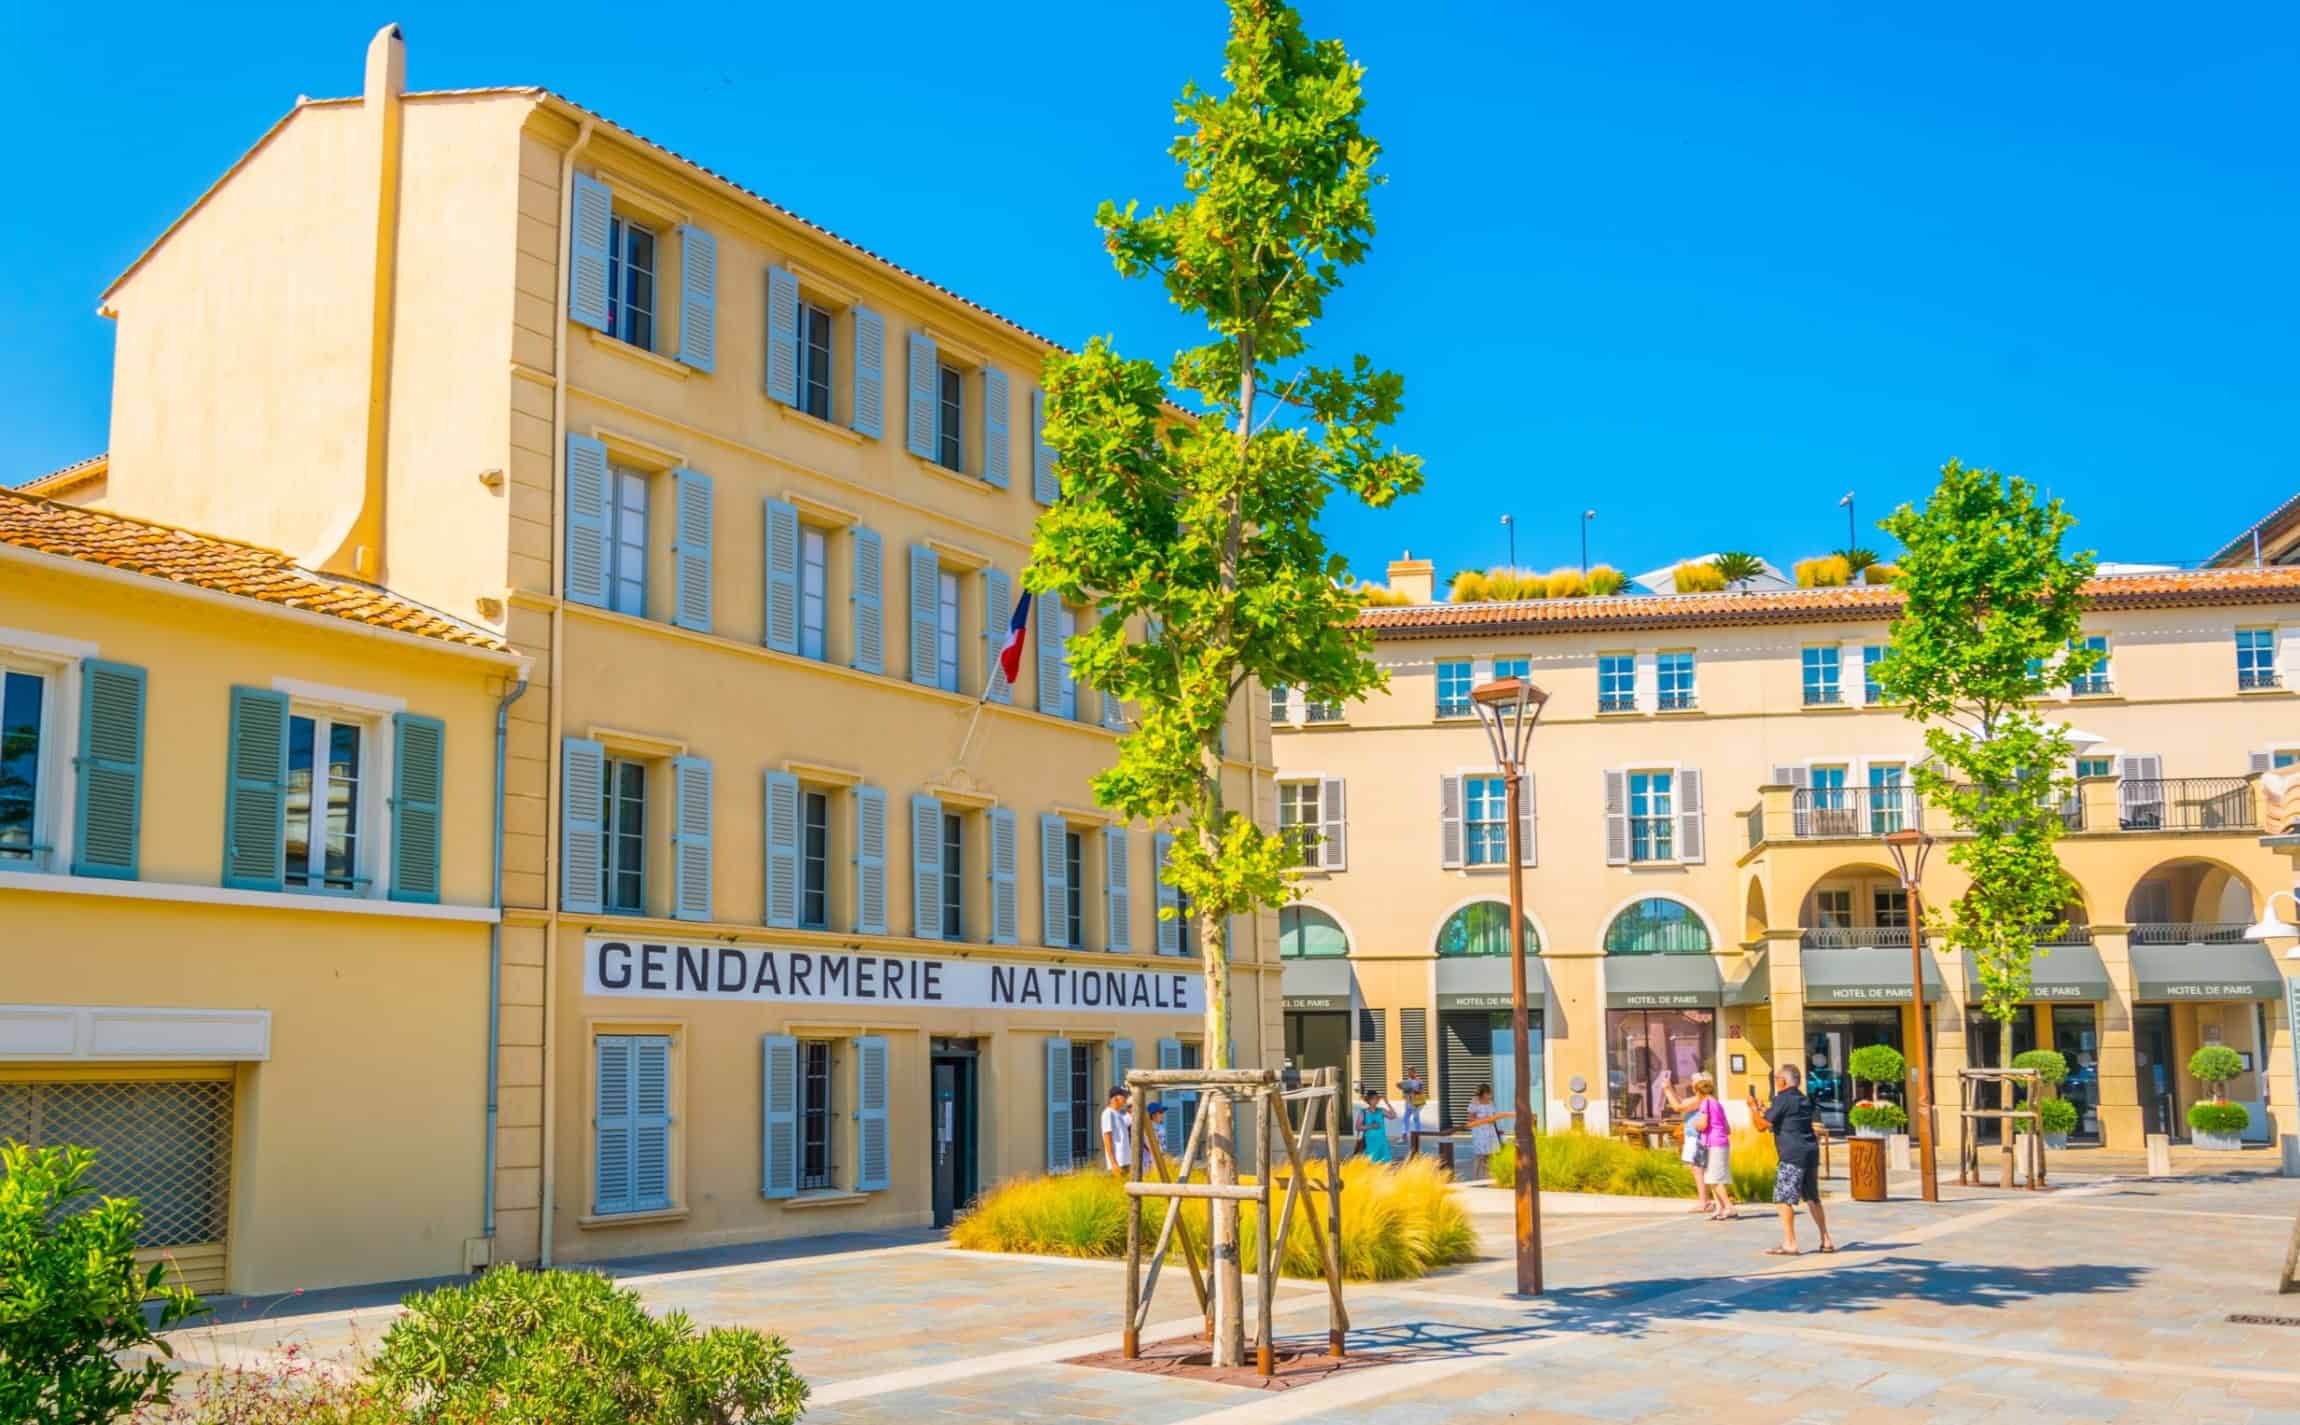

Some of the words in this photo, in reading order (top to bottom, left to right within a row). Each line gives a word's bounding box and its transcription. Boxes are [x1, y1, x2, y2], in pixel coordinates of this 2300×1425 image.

[598, 942, 943, 1001] GENDARMERIE
[991, 966, 1188, 1009] NATIONALE
[1832, 989, 1866, 998] HOTEL
[1868, 989, 1883, 998] DE
[1885, 988, 1913, 998] PARIS
[2034, 987, 2049, 996] DE
[2052, 986, 2081, 996] PARIS
[2167, 985, 2202, 995] HOTEL
[2205, 985, 2220, 994] DE
[2223, 985, 2253, 994] PARIS
[1293, 999, 1305, 1008] DE
[1306, 999, 1330, 1007] PARIS
[1456, 997, 1485, 1005] HOTEL
[1487, 997, 1499, 1005] DE
[1627, 996, 1657, 1004] HOTEL
[1659, 996, 1671, 1004] DE
[1672, 995, 1698, 1004] PARIS
